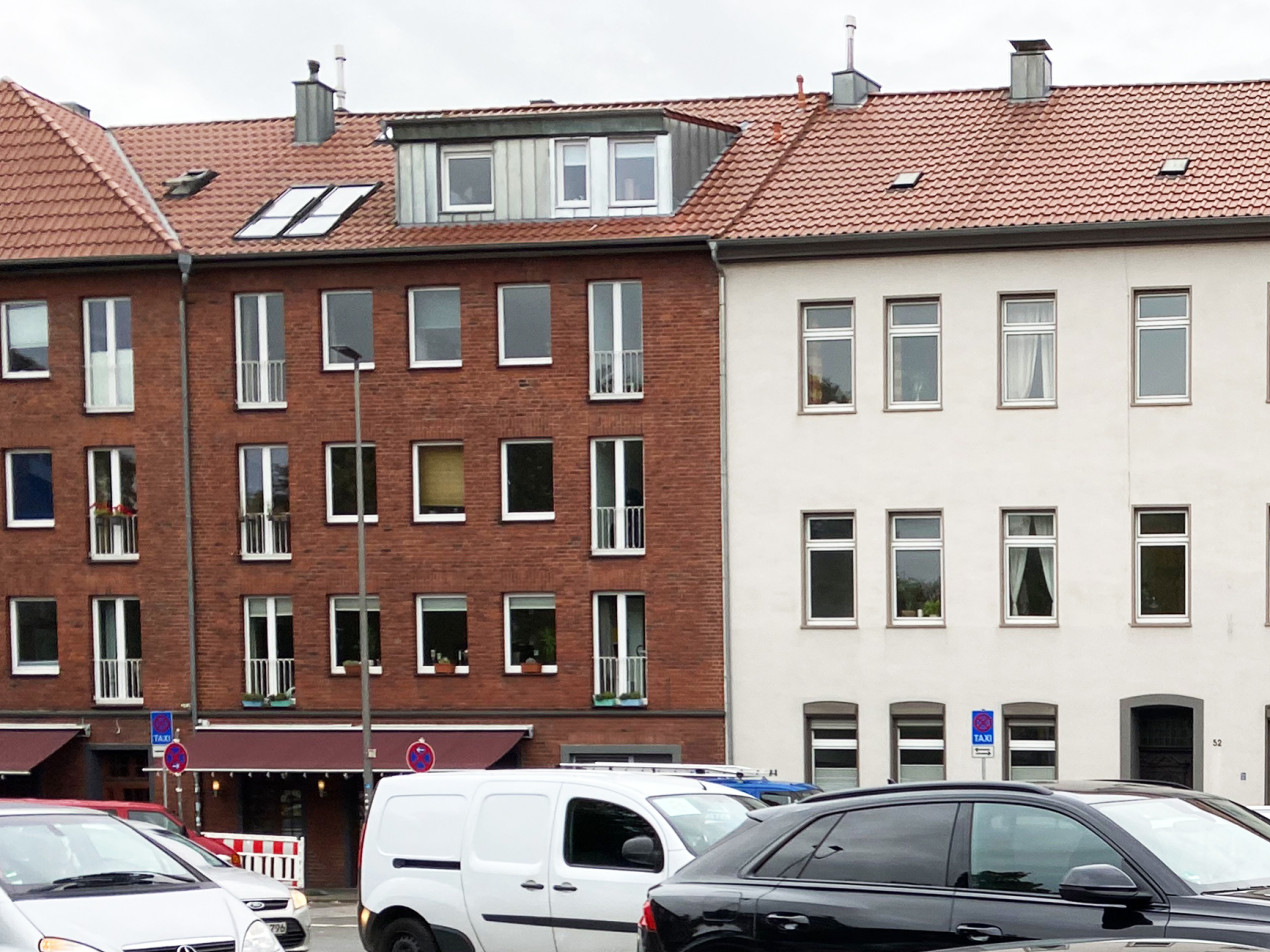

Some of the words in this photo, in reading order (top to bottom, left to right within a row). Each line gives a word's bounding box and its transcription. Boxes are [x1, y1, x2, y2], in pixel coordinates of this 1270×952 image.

[153, 734, 171, 742] TAXI
[974, 734, 993, 742] TAXI
[1212, 739, 1222, 747] 52
